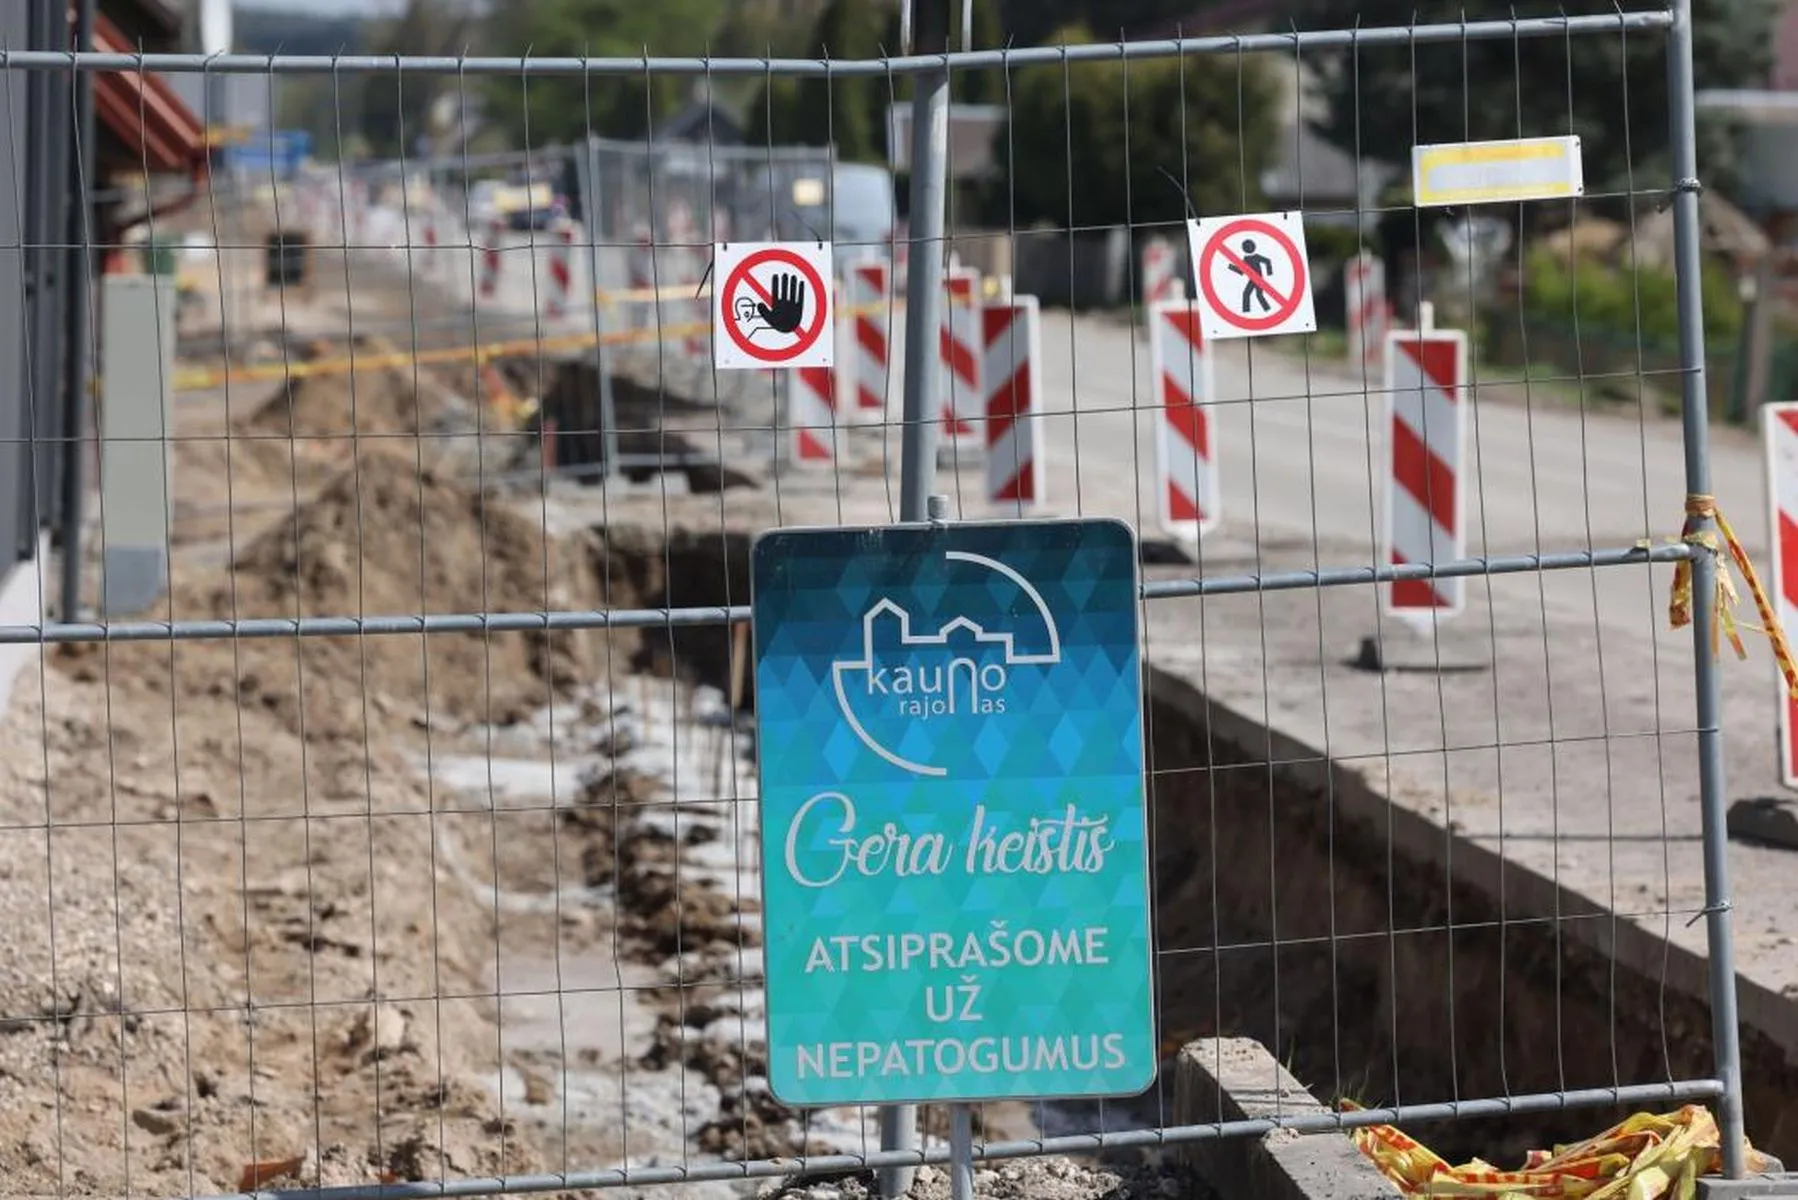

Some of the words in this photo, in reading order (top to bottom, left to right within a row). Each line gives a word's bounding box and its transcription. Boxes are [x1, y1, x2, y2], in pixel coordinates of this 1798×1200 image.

[867, 657, 1007, 713] kauno
[785, 791, 952, 888] Gera
[965, 803, 1115, 875] keistis
[804, 920, 1110, 973] ATSIPRAŠOME
[925, 974, 983, 1022] UŽ
[796, 1033, 1126, 1079] NEPATOGUMUS
